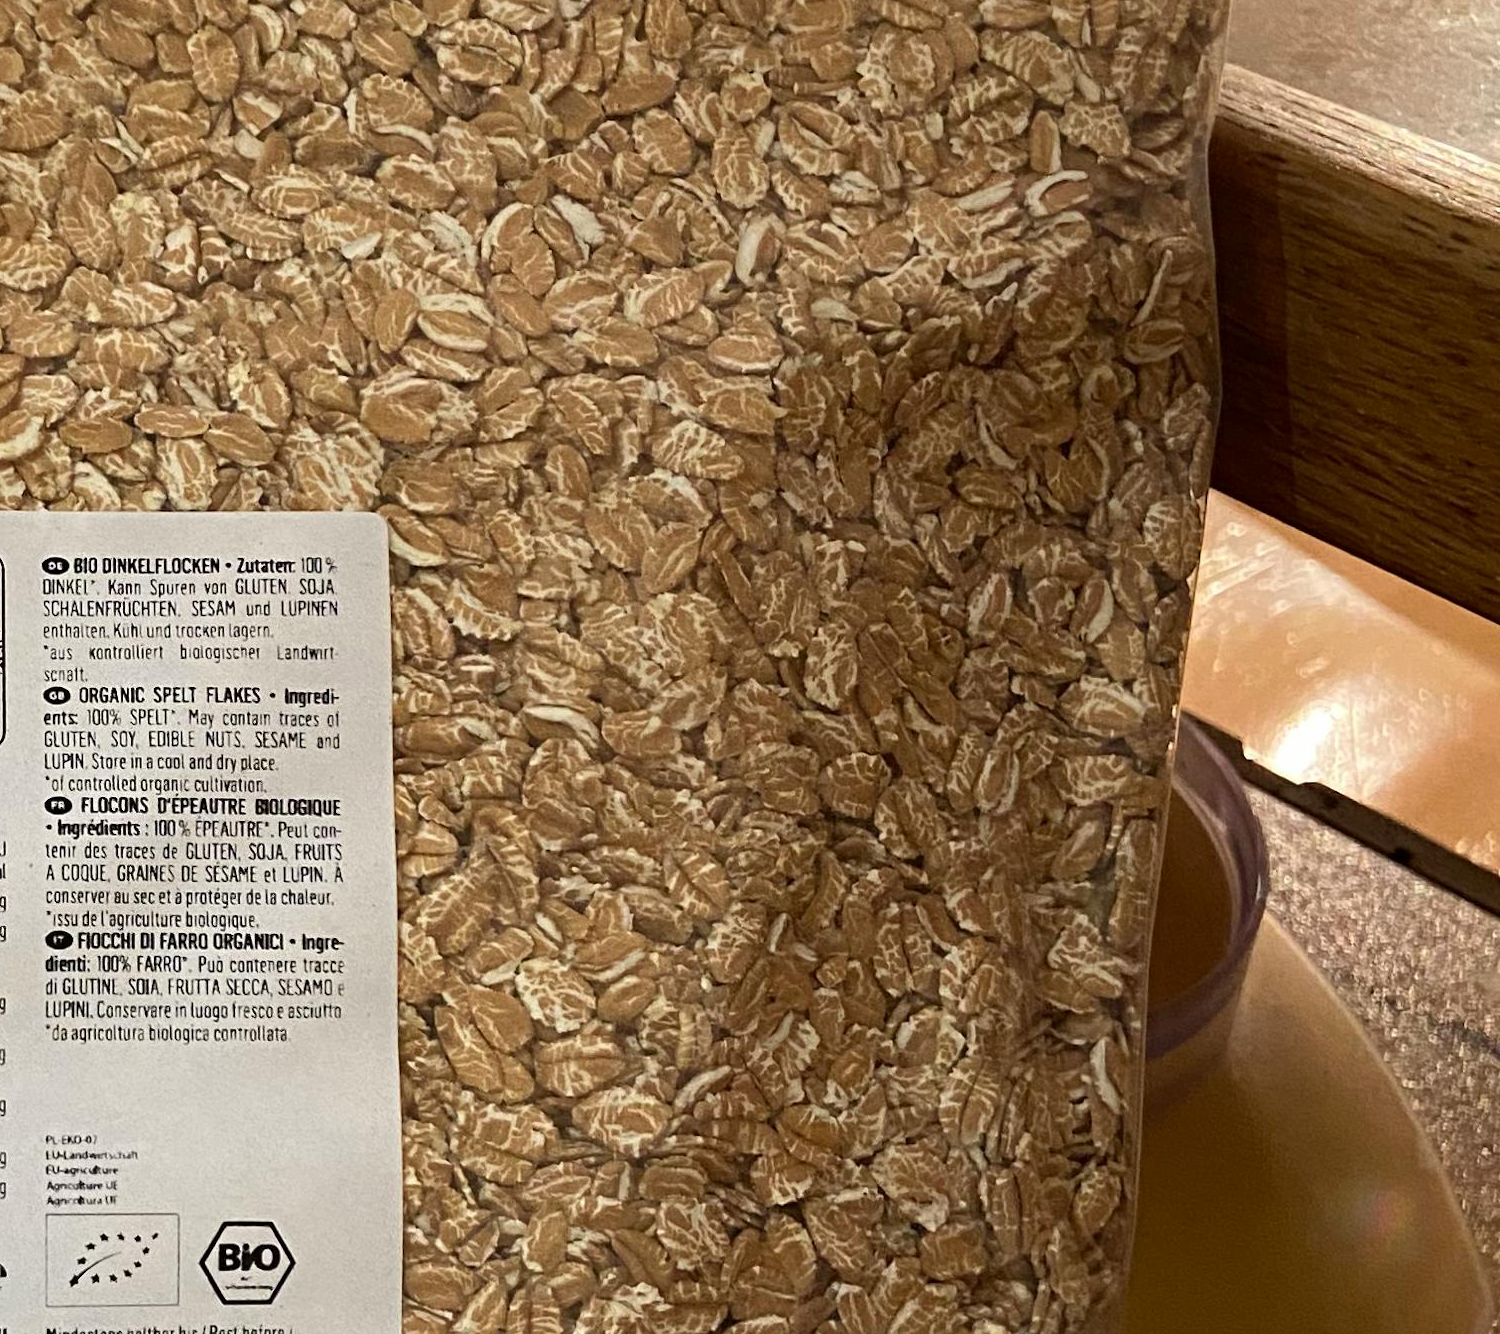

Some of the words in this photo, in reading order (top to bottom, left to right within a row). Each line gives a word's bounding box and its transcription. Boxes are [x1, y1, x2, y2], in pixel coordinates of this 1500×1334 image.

[74, 557, 97, 574] BIO
[102, 558, 219, 574] DINKELFLOCKEN
[301, 557, 322, 573] 100
[108, 580, 141, 595] Kann
[150, 579, 195, 598] Spuren
[204, 583, 226, 595] von
[192, 600, 235, 616] SESAM
[247, 601, 270, 616] und
[281, 601, 337, 616] LUPINEN
[147, 624, 171, 638] und
[79, 687, 145, 703] ORGANIC
[154, 687, 196, 703] SPELT
[207, 687, 260, 704] FLAKES
[285, 688, 339, 708] Ingredi-
[87, 709, 121, 725] 100%
[189, 709, 214, 729] May
[223, 712, 270, 726] contain
[279, 713, 319, 727] traces
[149, 731, 195, 747] EDIBLE
[255, 731, 306, 748] SESAME
[317, 734, 340, 749] and
[92, 753, 126, 769] Store
[158, 754, 184, 769] cool
[217, 754, 236, 774] dry
[68, 775, 136, 791] controlled
[141, 779, 189, 797] organic
[81, 797, 148, 814] FLOCONS
[255, 799, 340, 817] BIOLOGIQUE
[155, 820, 175, 836] 100
[115, 844, 155, 859] traces
[117, 864, 174, 882] GRAINES
[182, 865, 198, 882] DE
[0, 896, 6, 912] g
[246, 889, 261, 905] de
[0, 926, 6, 942] g
[78, 932, 135, 950] FIOCCHI
[140, 932, 155, 950] DI
[160, 933, 208, 950] FARRO
[213, 933, 284, 950] ORGANICI
[302, 934, 344, 954] Ingre-
[45, 955, 90, 972] dienti:
[97, 955, 131, 972] 100%
[230, 959, 296, 973] contenere
[0, 998, 6, 1015] g
[97, 1000, 171, 1018] Conservare
[191, 1002, 228, 1022] luogo
[71, 1025, 144, 1044] agricoltura
[149, 1025, 209, 1044] biologica
[0, 1049, 6, 1066] g
[0, 1100, 6, 1117] g
[0, 1152, 6, 1169] g
[0, 1182, 6, 1199] g
